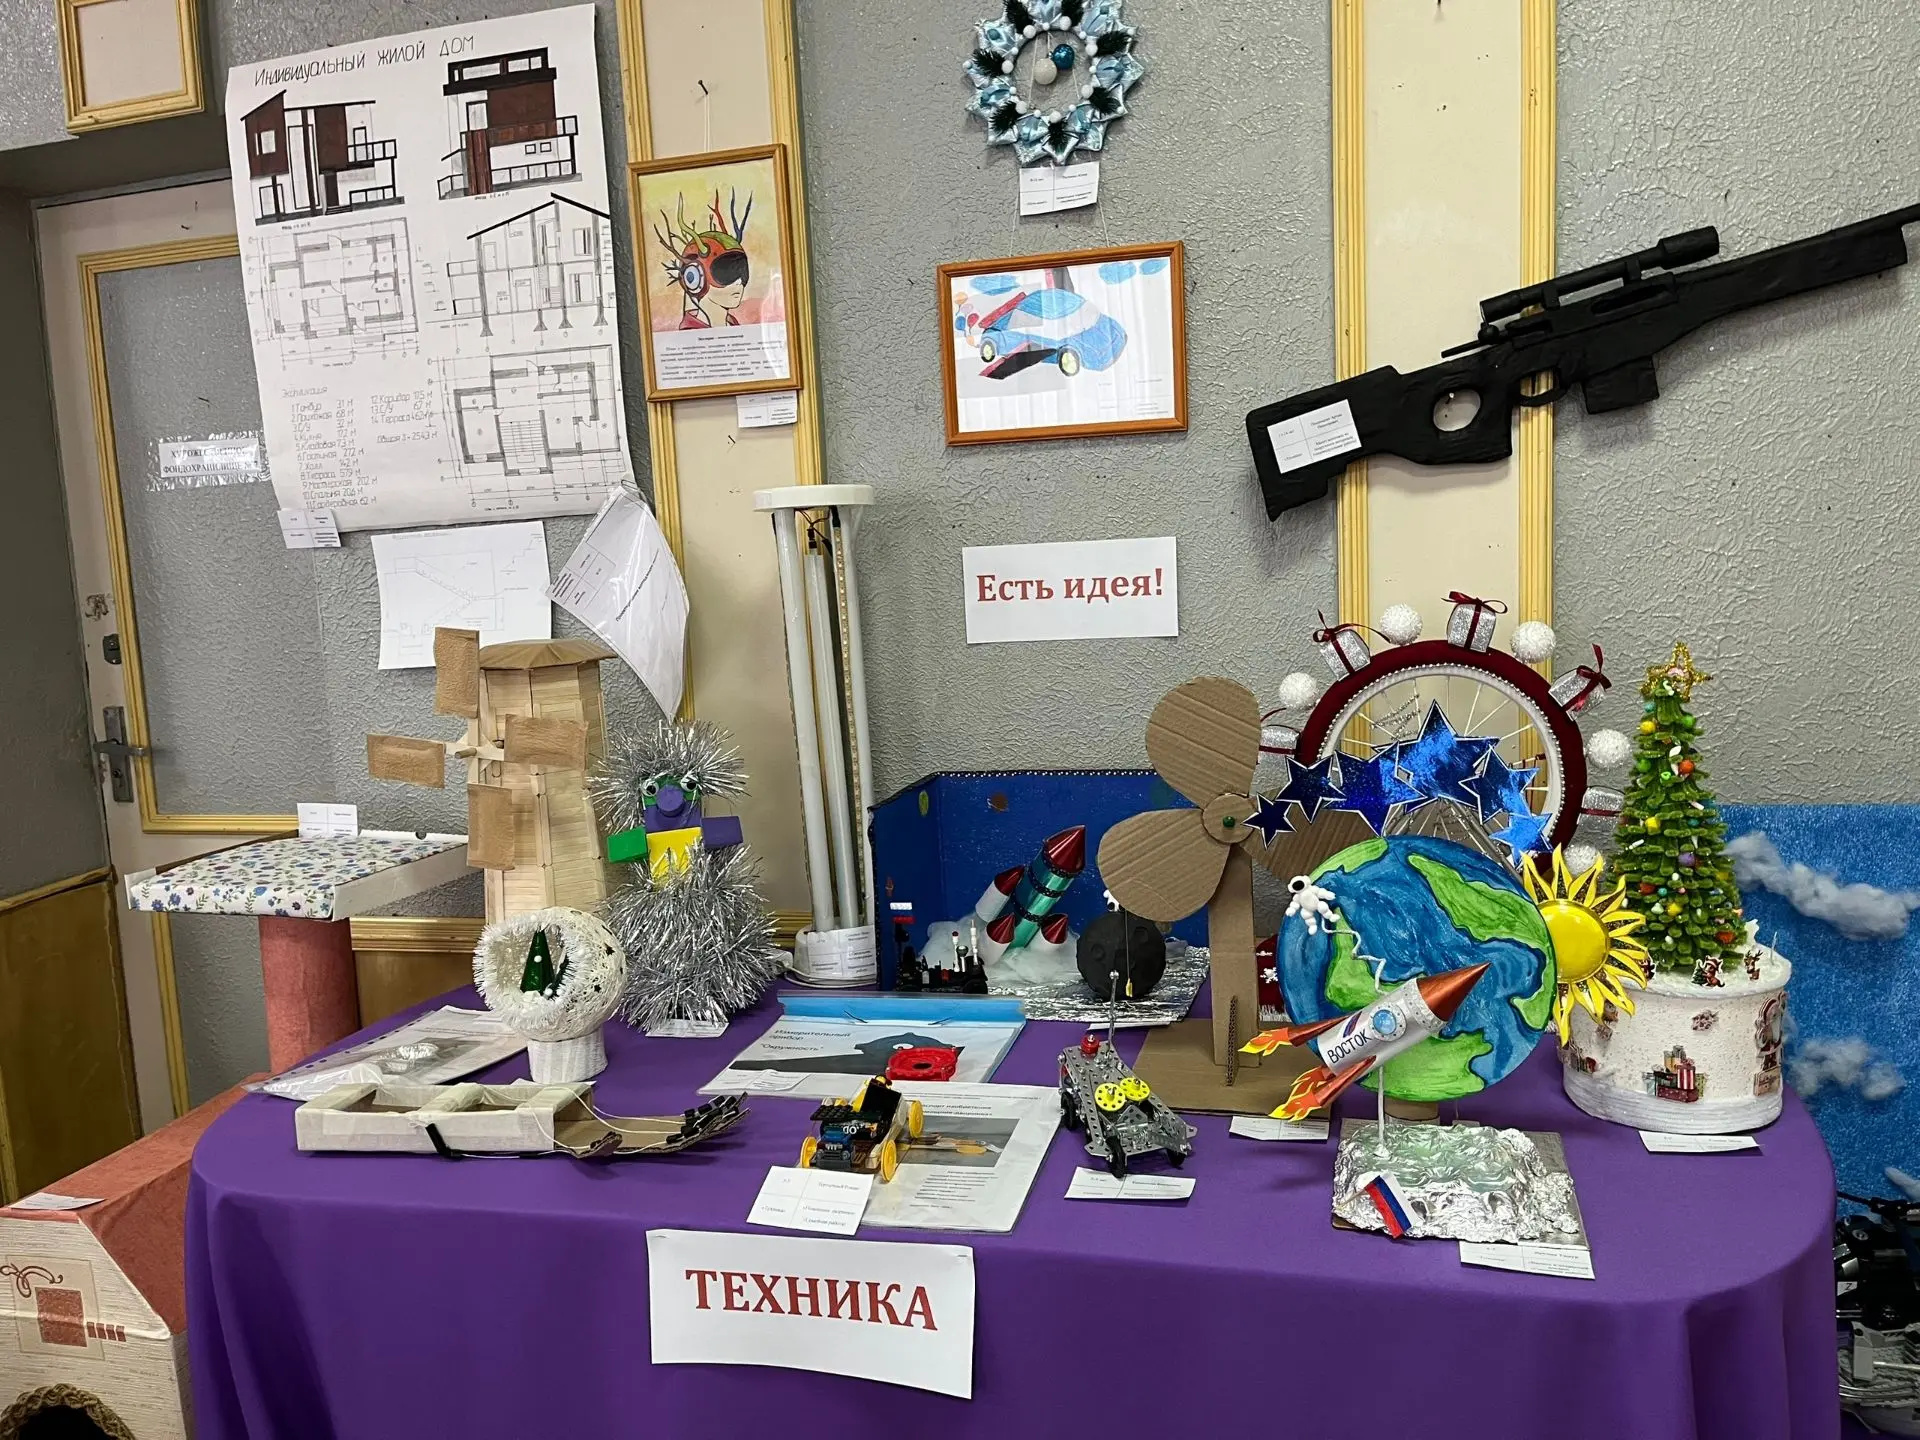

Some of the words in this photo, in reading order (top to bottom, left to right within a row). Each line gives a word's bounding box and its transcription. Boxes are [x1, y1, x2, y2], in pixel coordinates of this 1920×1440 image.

[977, 574, 1054, 602] Есть
[1063, 567, 1163, 604] идея!
[1327, 1028, 1373, 1063] ВОСТОК
[685, 1269, 938, 1331] ТЕХНИКА
